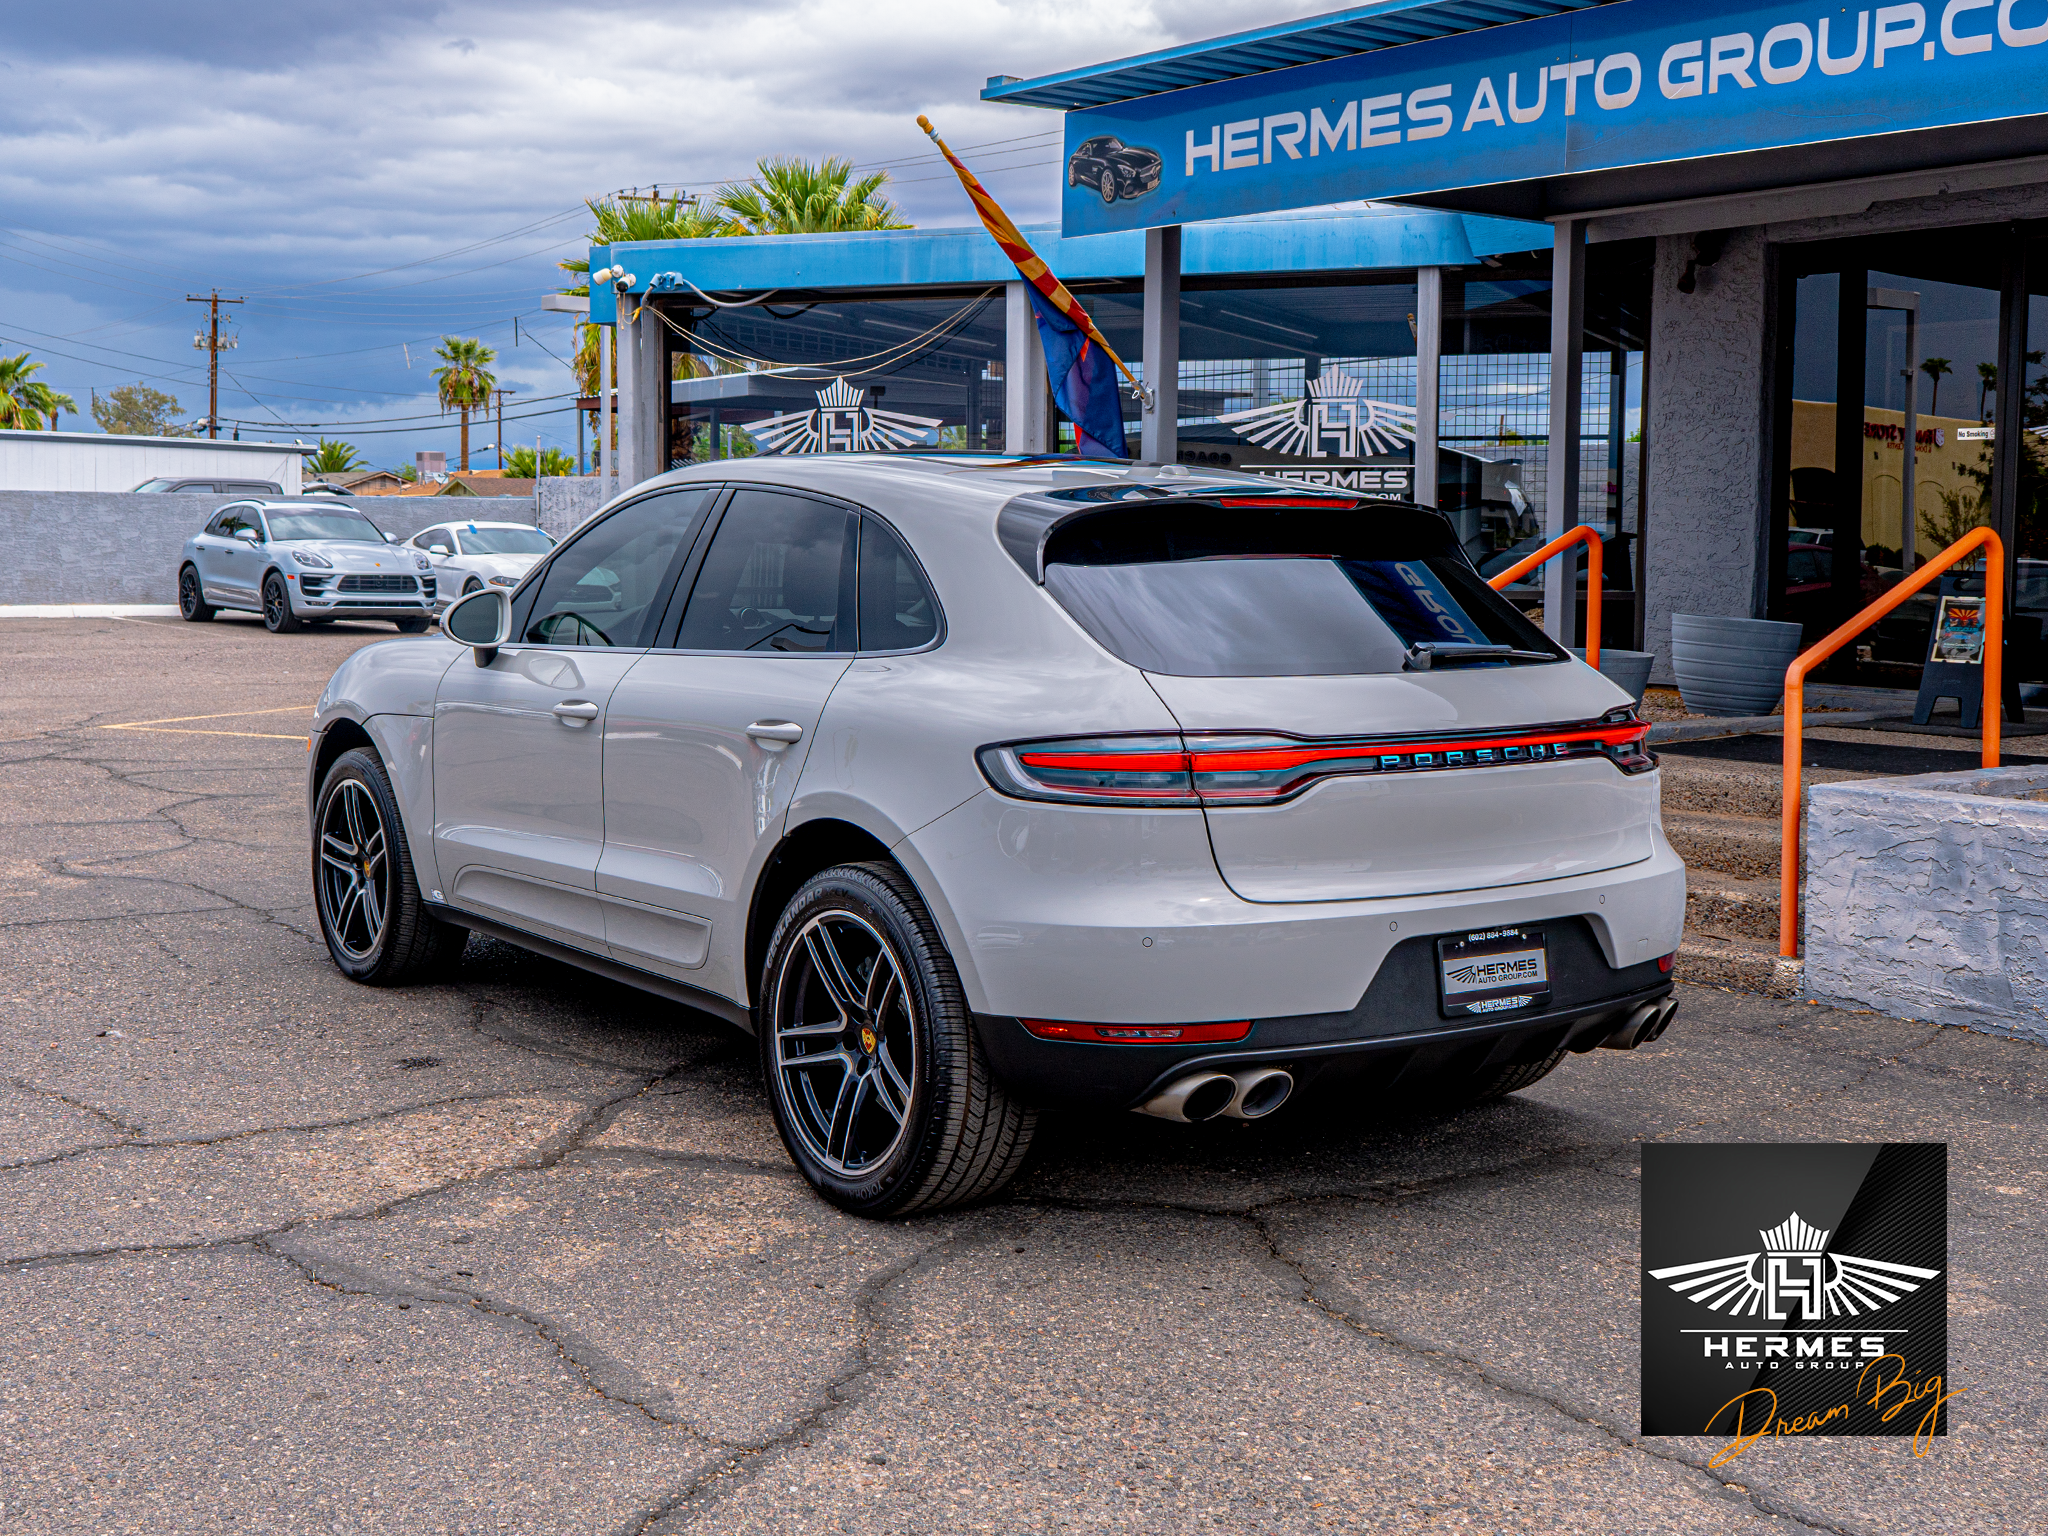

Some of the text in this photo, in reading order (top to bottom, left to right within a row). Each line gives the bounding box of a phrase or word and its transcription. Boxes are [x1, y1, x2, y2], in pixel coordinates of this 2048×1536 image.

[1185, 84, 1453, 177] HERMES
[1462, 51, 1642, 133] AUTO
[1966, 430, 1989, 439] Smoking
[1380, 743, 1569, 770] PORSCHE
[1469, 932, 1485, 942] (602)
[1476, 958, 1537, 976] HERMES
[1478, 970, 1537, 985] AUTO GROUP.COM
[1481, 997, 1518, 1009] HERMES
